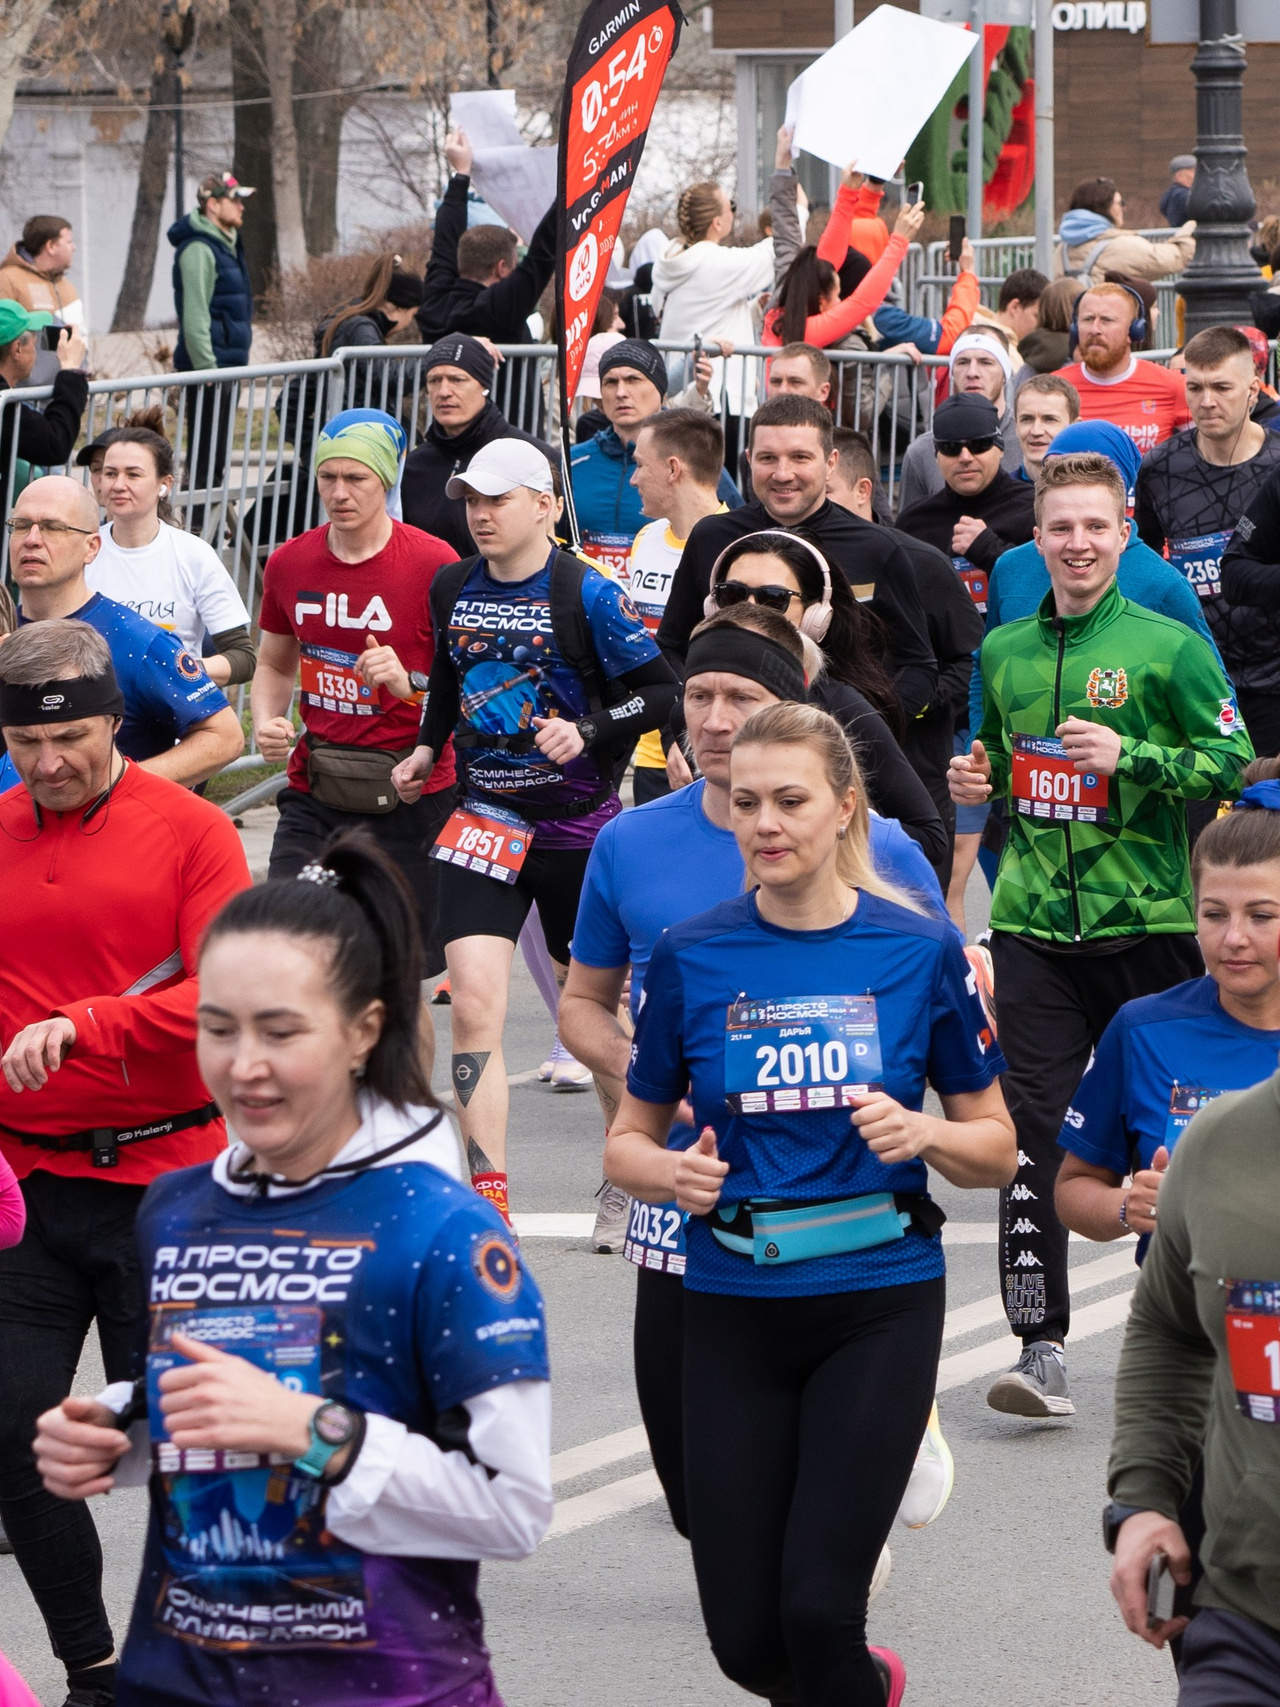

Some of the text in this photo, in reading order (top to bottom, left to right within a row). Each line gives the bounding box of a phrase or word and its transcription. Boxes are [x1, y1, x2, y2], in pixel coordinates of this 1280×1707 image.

[588, 0, 641, 55] GARMIN
[1050, 1, 1147, 34] ОЛИЦ
[581, 33, 647, 134] 0:54
[295, 590, 392, 631] FILA
[316, 671, 358, 701] 1339
[1036, 746, 1067, 755] КОСМО
[1029, 769, 1080, 802] 1601
[455, 825, 505, 860] 1851
[767, 1009, 829, 1020] КОСМОС
[776, 1002, 828, 1011] ПРОСТО
[779, 1027, 812, 1038] ДАРЬЯ
[755, 1040, 868, 1086] 2010 D
[134, 1121, 173, 1138] Kalenji
[630, 1200, 681, 1249] 2032
[1005, 1274, 1045, 1289] #LIVE
[1006, 1290, 1046, 1307] AUTH
[1008, 1308, 1045, 1324] ENTIC
